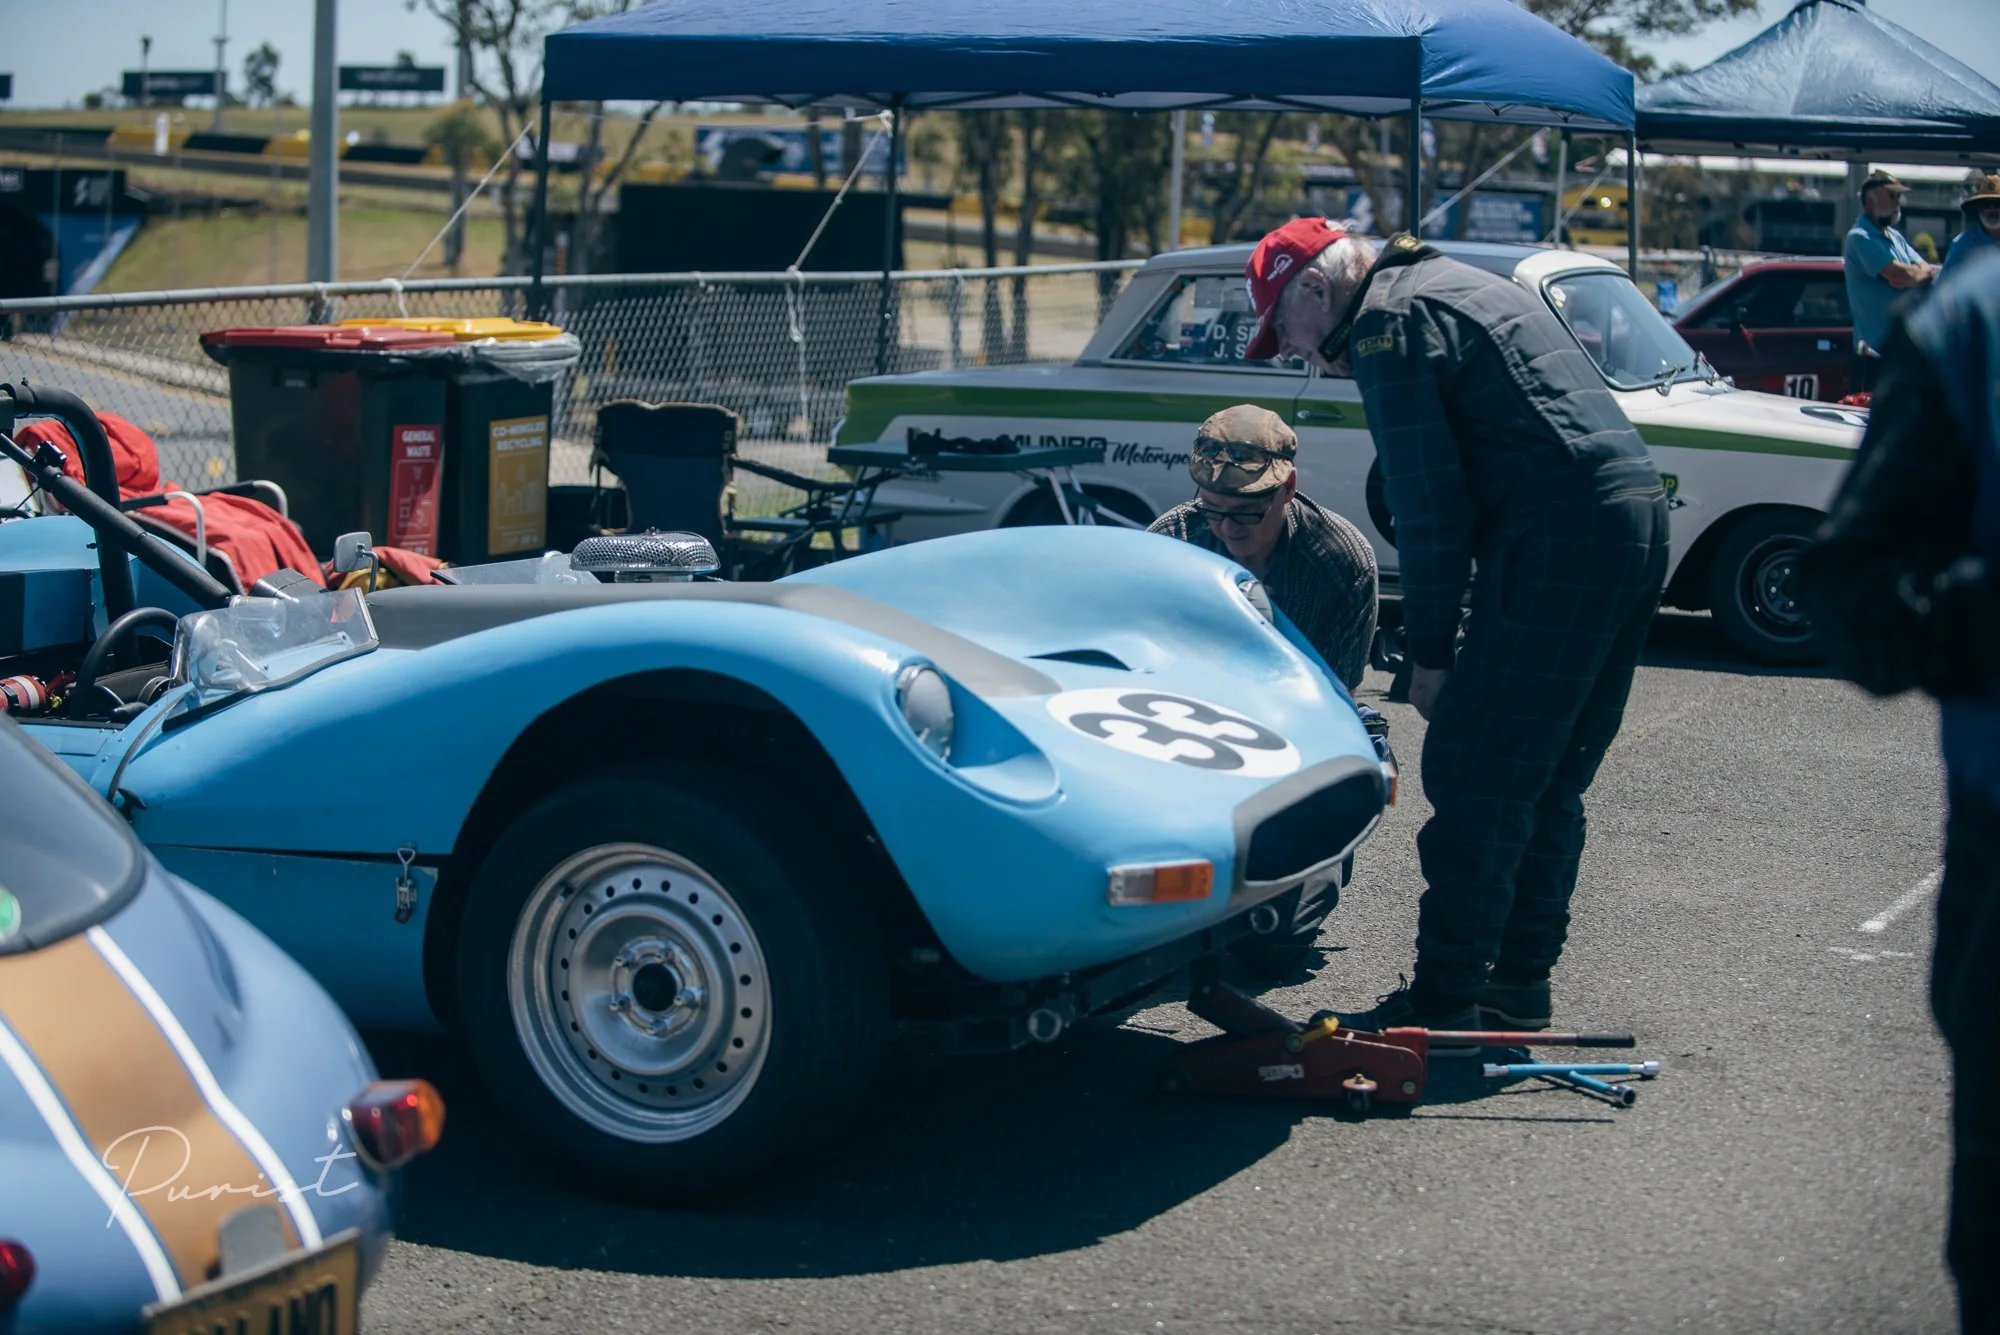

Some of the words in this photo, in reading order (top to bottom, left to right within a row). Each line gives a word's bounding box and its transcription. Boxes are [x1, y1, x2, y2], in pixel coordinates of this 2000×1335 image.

[1213, 325, 1230, 340] D.
[1213, 343, 1229, 358] J.
[1068, 692, 1288, 771] 33
